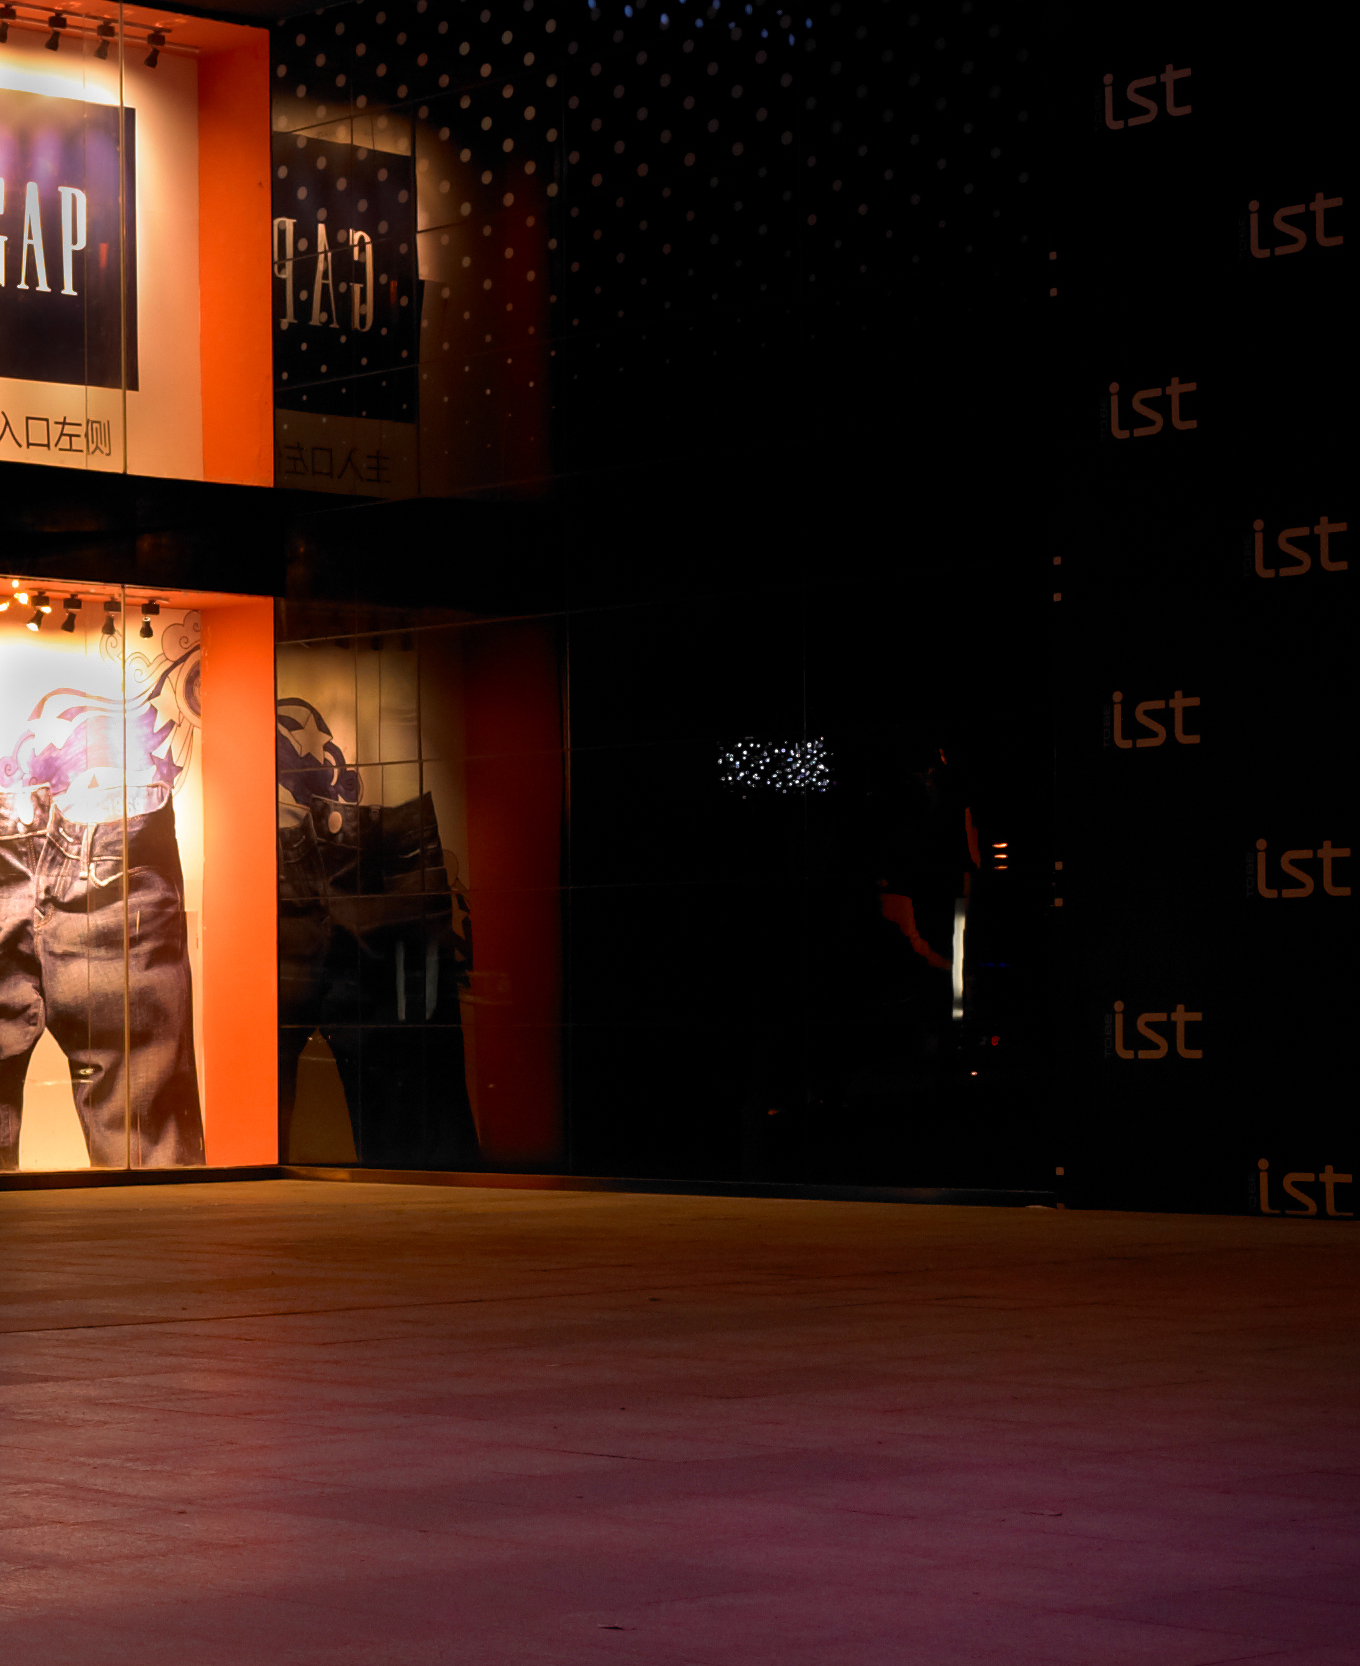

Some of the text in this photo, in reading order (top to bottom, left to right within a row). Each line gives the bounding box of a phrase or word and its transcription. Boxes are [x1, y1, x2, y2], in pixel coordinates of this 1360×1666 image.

[1104, 64, 1191, 130] ist
[1249, 193, 1343, 258] ist
[1109, 377, 1197, 439] ist
[1253, 516, 1348, 578] ist
[1112, 690, 1200, 748] ist
[1256, 839, 1351, 898] ist
[1114, 1000, 1203, 1059] ist
[1258, 1158, 1353, 1216] ist
